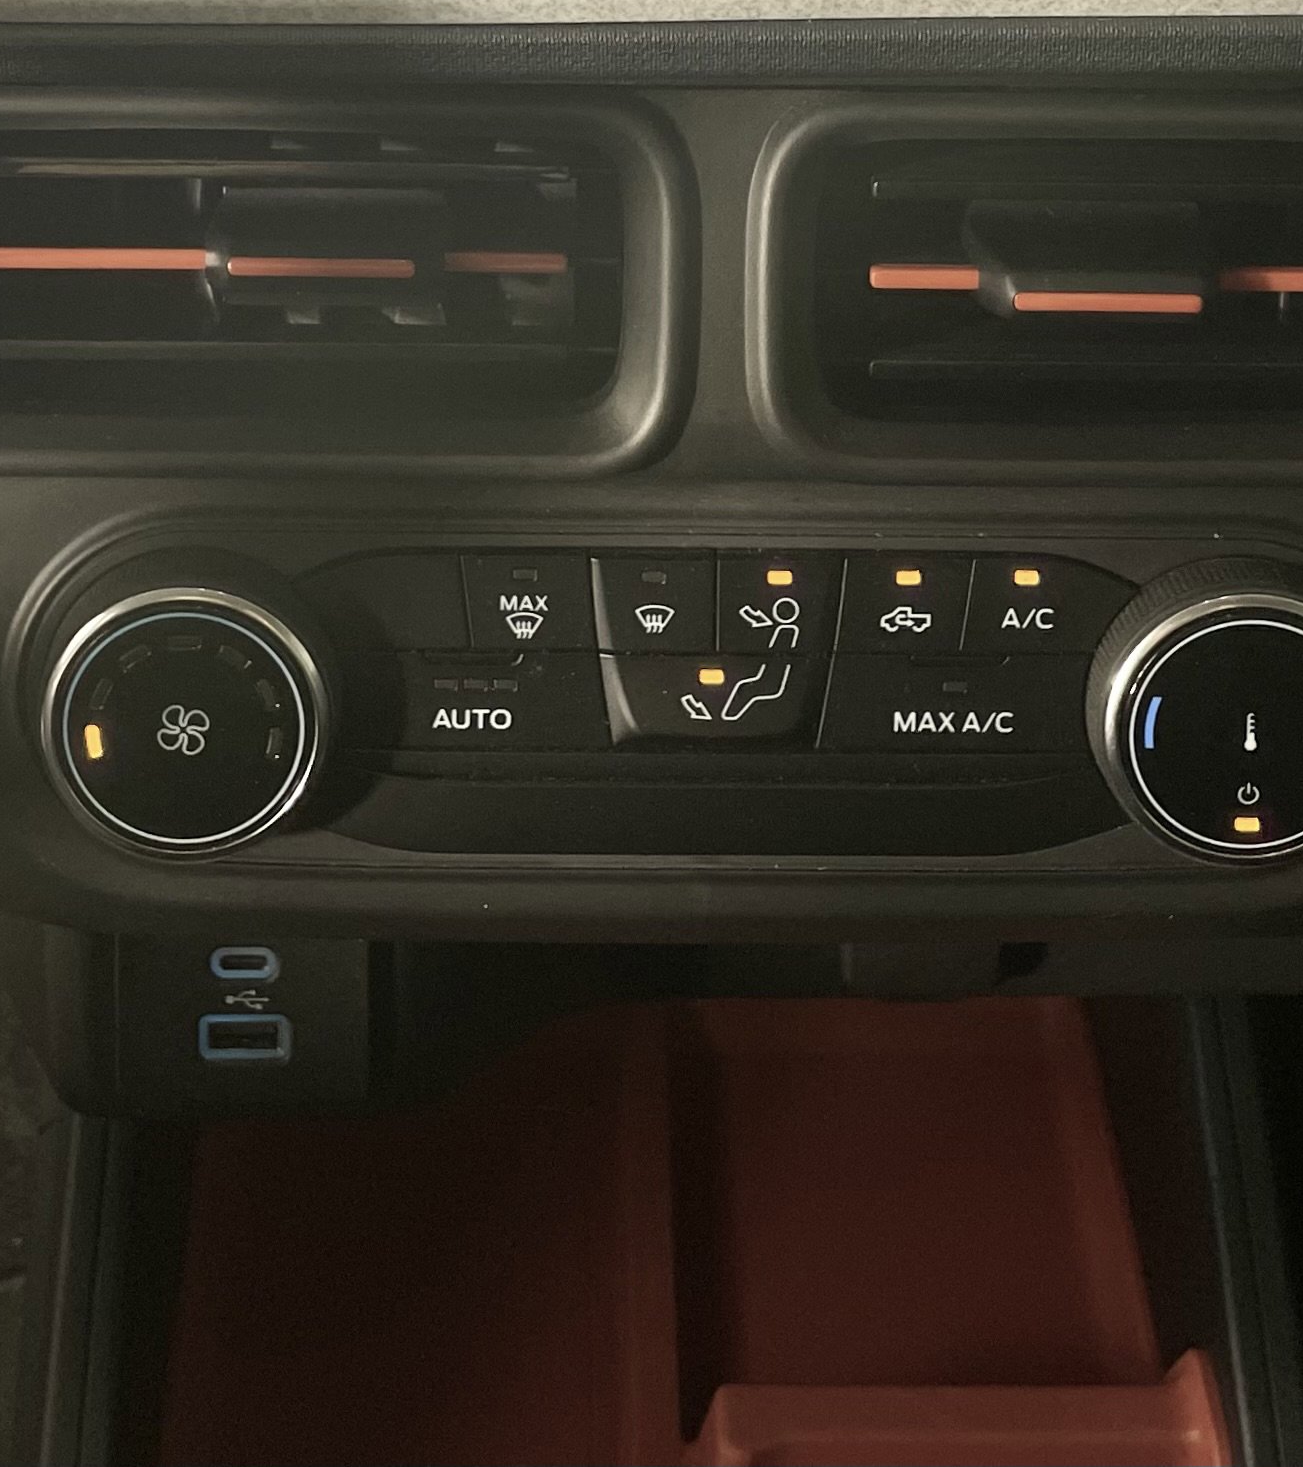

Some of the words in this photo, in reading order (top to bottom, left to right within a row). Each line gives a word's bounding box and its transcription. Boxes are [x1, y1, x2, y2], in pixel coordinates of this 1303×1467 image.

[499, 596, 548, 611] MAX
[1001, 609, 1053, 629] A/C
[432, 708, 512, 730] AUTO
[893, 711, 955, 733] MAX
[961, 711, 1014, 734] A/C
